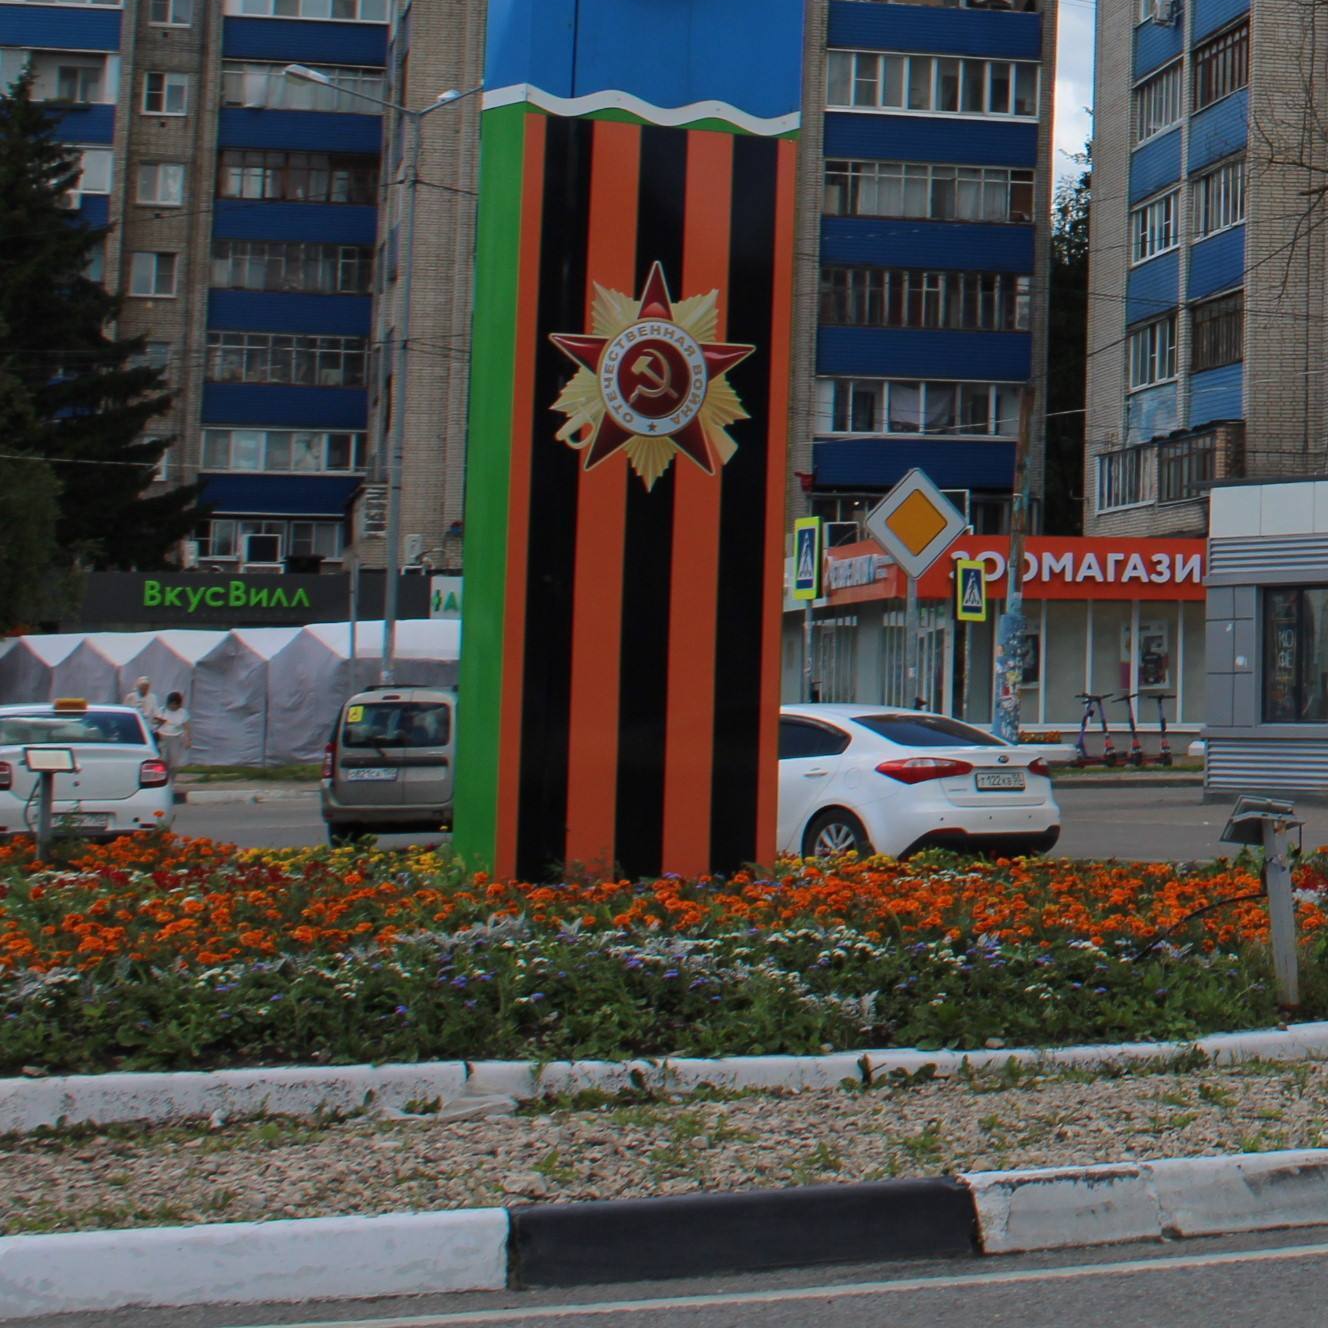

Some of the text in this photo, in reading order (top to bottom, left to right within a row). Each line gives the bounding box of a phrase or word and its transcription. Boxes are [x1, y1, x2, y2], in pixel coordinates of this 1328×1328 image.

[603, 324, 705, 426] ОТЕЧЕСТВЕННАЯ ВОЙНА
[949, 550, 1201, 584] ООМАГАЗИ
